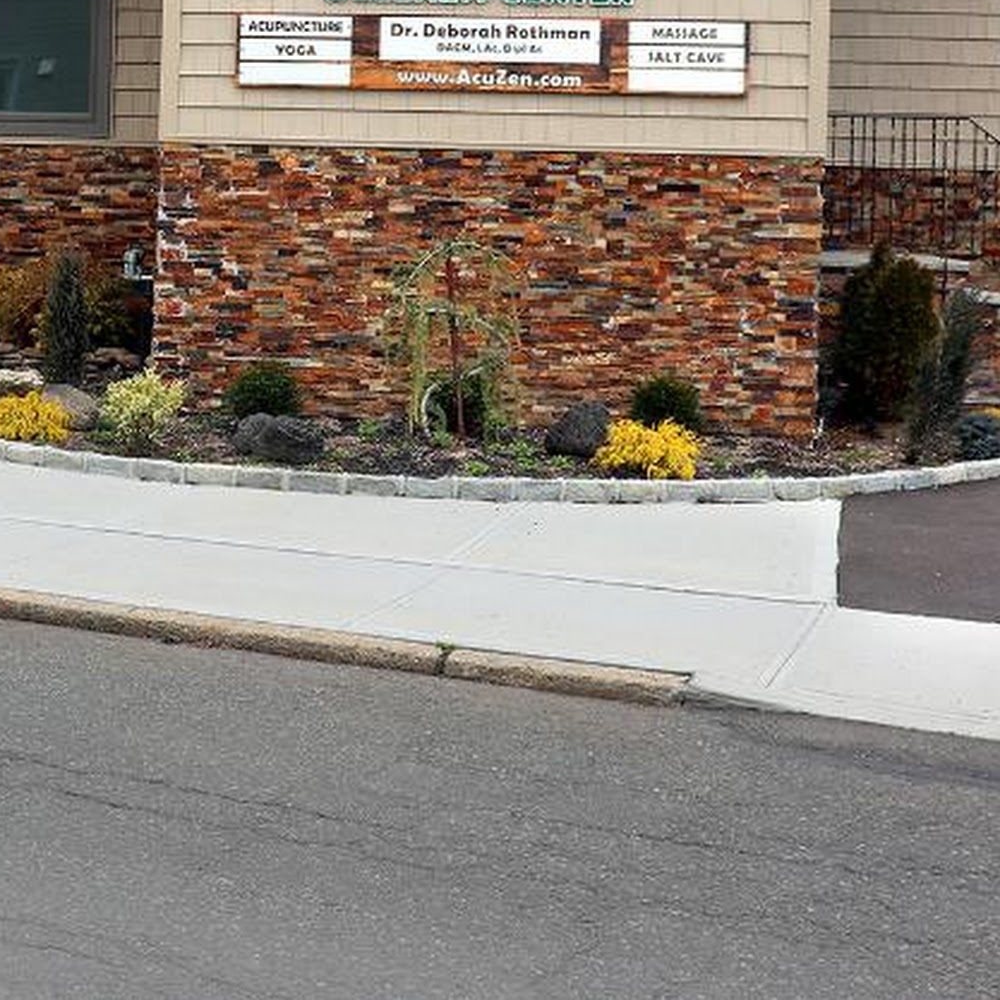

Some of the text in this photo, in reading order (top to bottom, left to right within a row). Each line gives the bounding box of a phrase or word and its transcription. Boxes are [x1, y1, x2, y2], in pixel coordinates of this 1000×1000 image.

[249, 20, 343, 33] ACUPUNCTURE
[389, 23, 591, 40] Dr. Deborah Rothman
[652, 28, 718, 39] MASSAGE
[275, 44, 317, 56] YOGA
[649, 52, 726, 64] SALT CAVE
[396, 69, 582, 88] www.AcuZen.com
